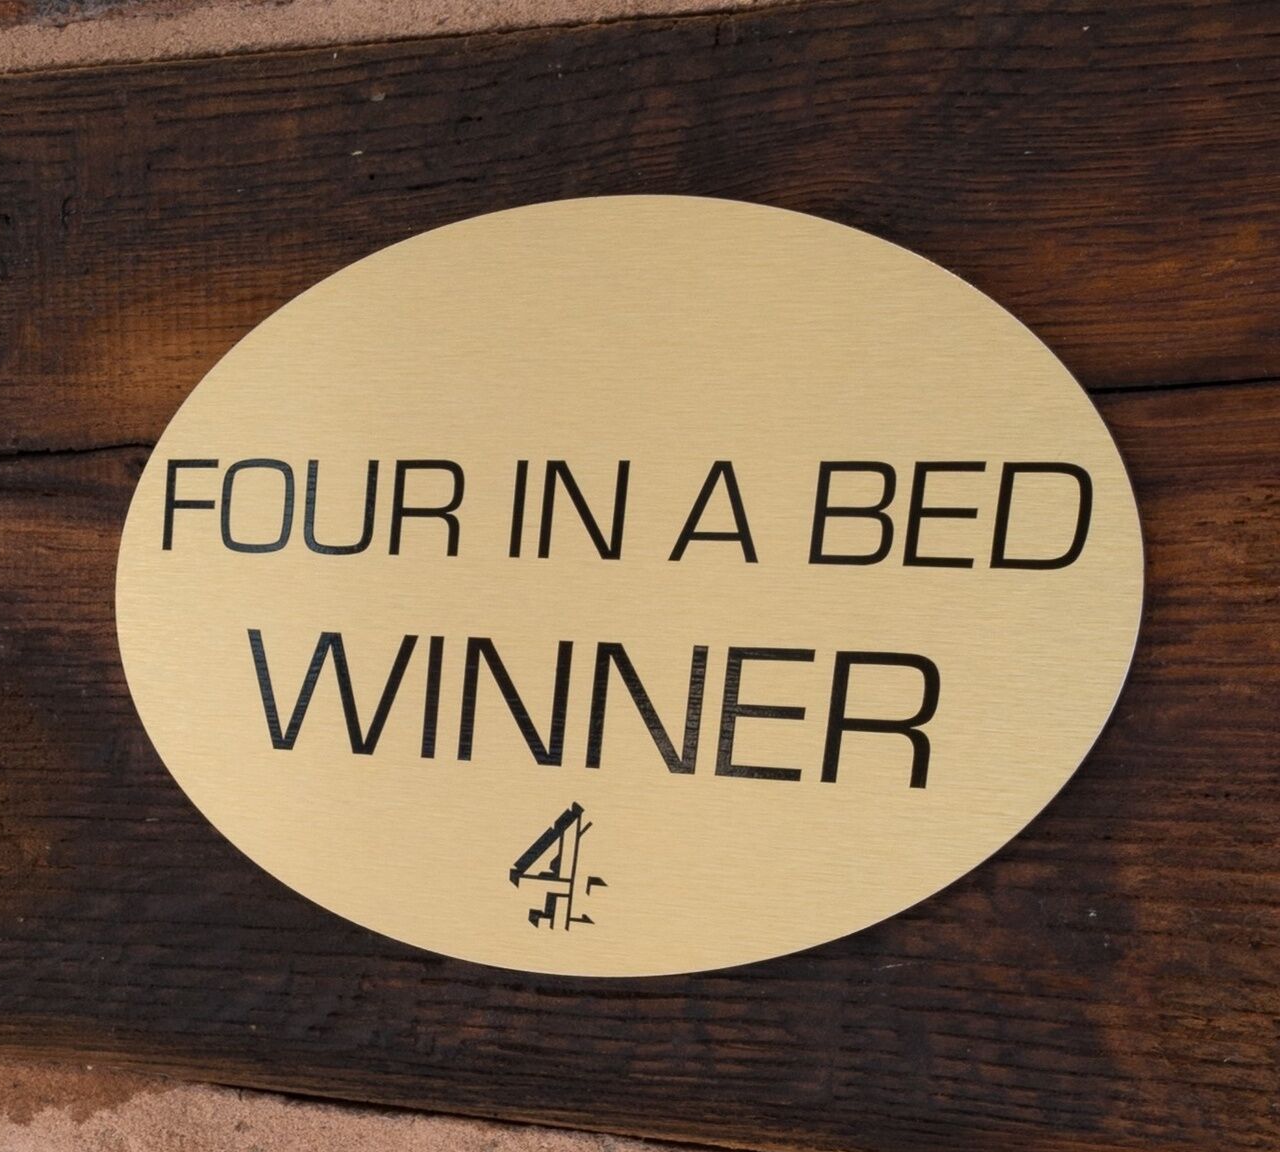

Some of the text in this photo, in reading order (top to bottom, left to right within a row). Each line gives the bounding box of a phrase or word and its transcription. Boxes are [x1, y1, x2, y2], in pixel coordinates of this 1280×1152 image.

[160, 457, 1095, 571] FOUR IN A BED
[246, 627, 942, 789] WINNER
